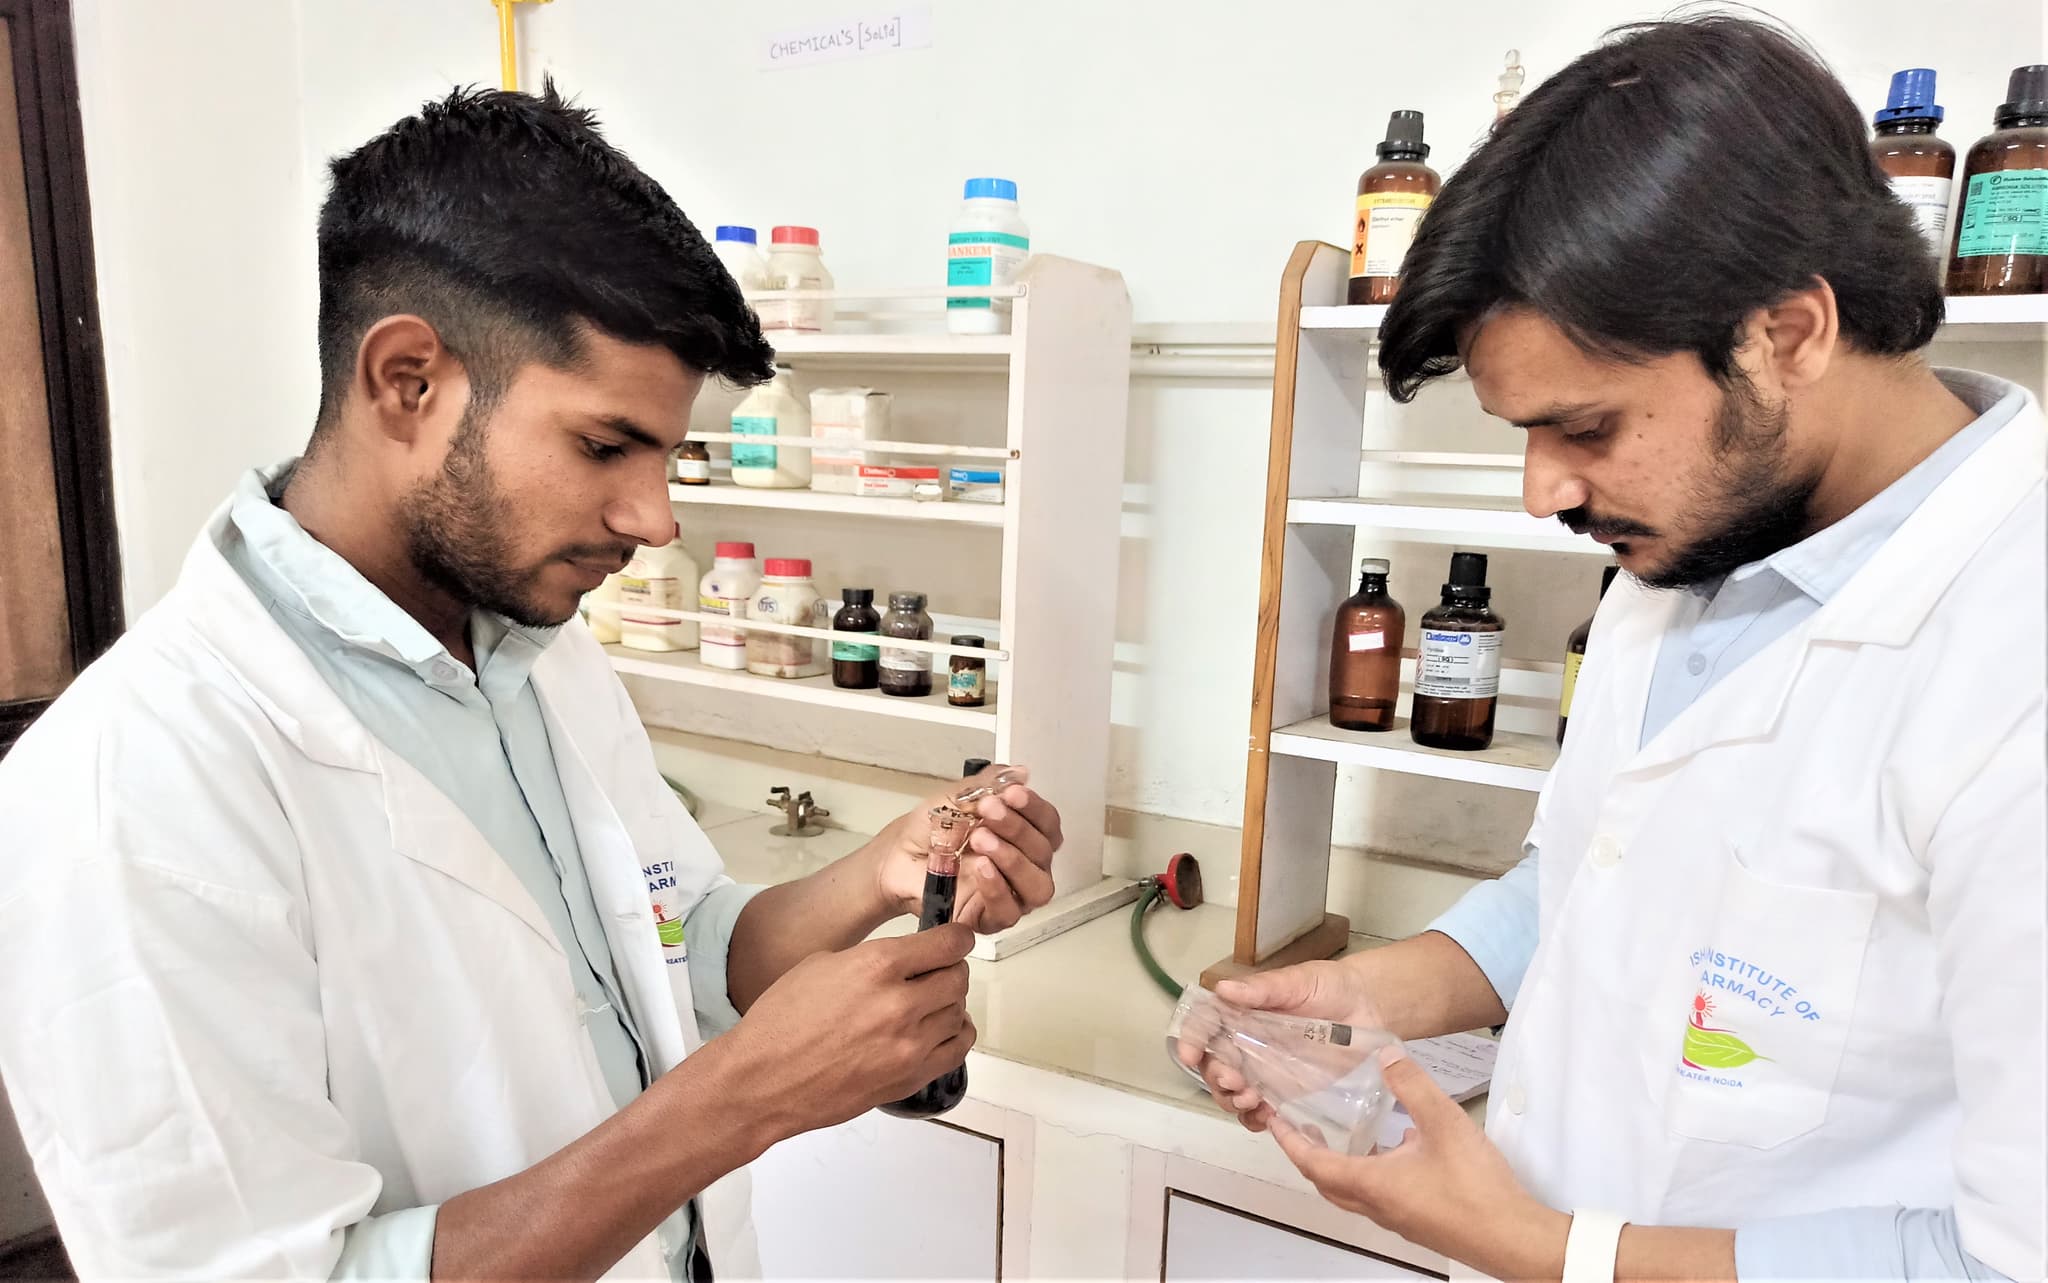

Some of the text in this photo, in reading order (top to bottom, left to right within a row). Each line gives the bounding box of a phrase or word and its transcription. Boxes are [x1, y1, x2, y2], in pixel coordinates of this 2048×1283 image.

[769, 29, 854, 59] CHEMICAL'S
[1794, 1001, 1821, 1022] OF
[1713, 1076, 1743, 1088] NOIDA
